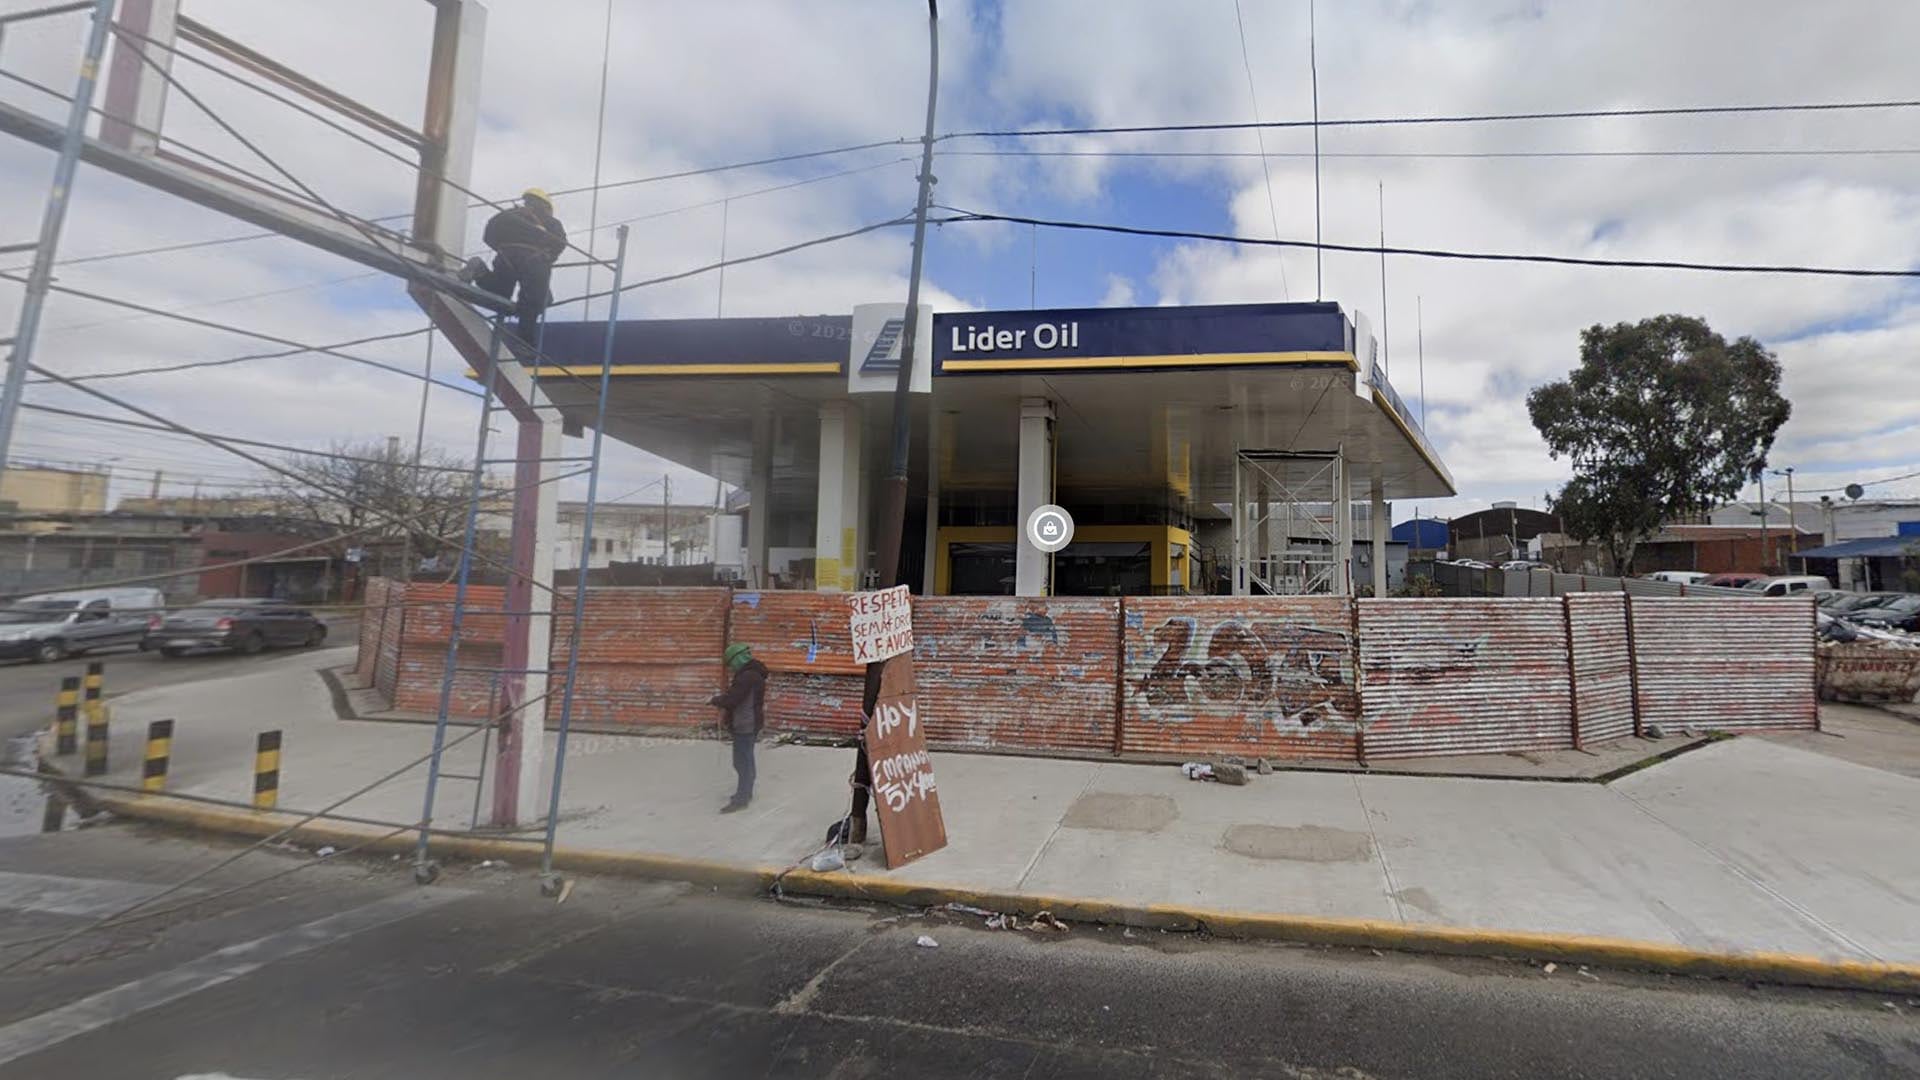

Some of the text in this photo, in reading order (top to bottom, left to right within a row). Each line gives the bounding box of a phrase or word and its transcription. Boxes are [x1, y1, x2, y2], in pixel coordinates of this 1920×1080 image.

[952, 321, 1078, 352] Lider Oil
[875, 699, 917, 740] HOY
